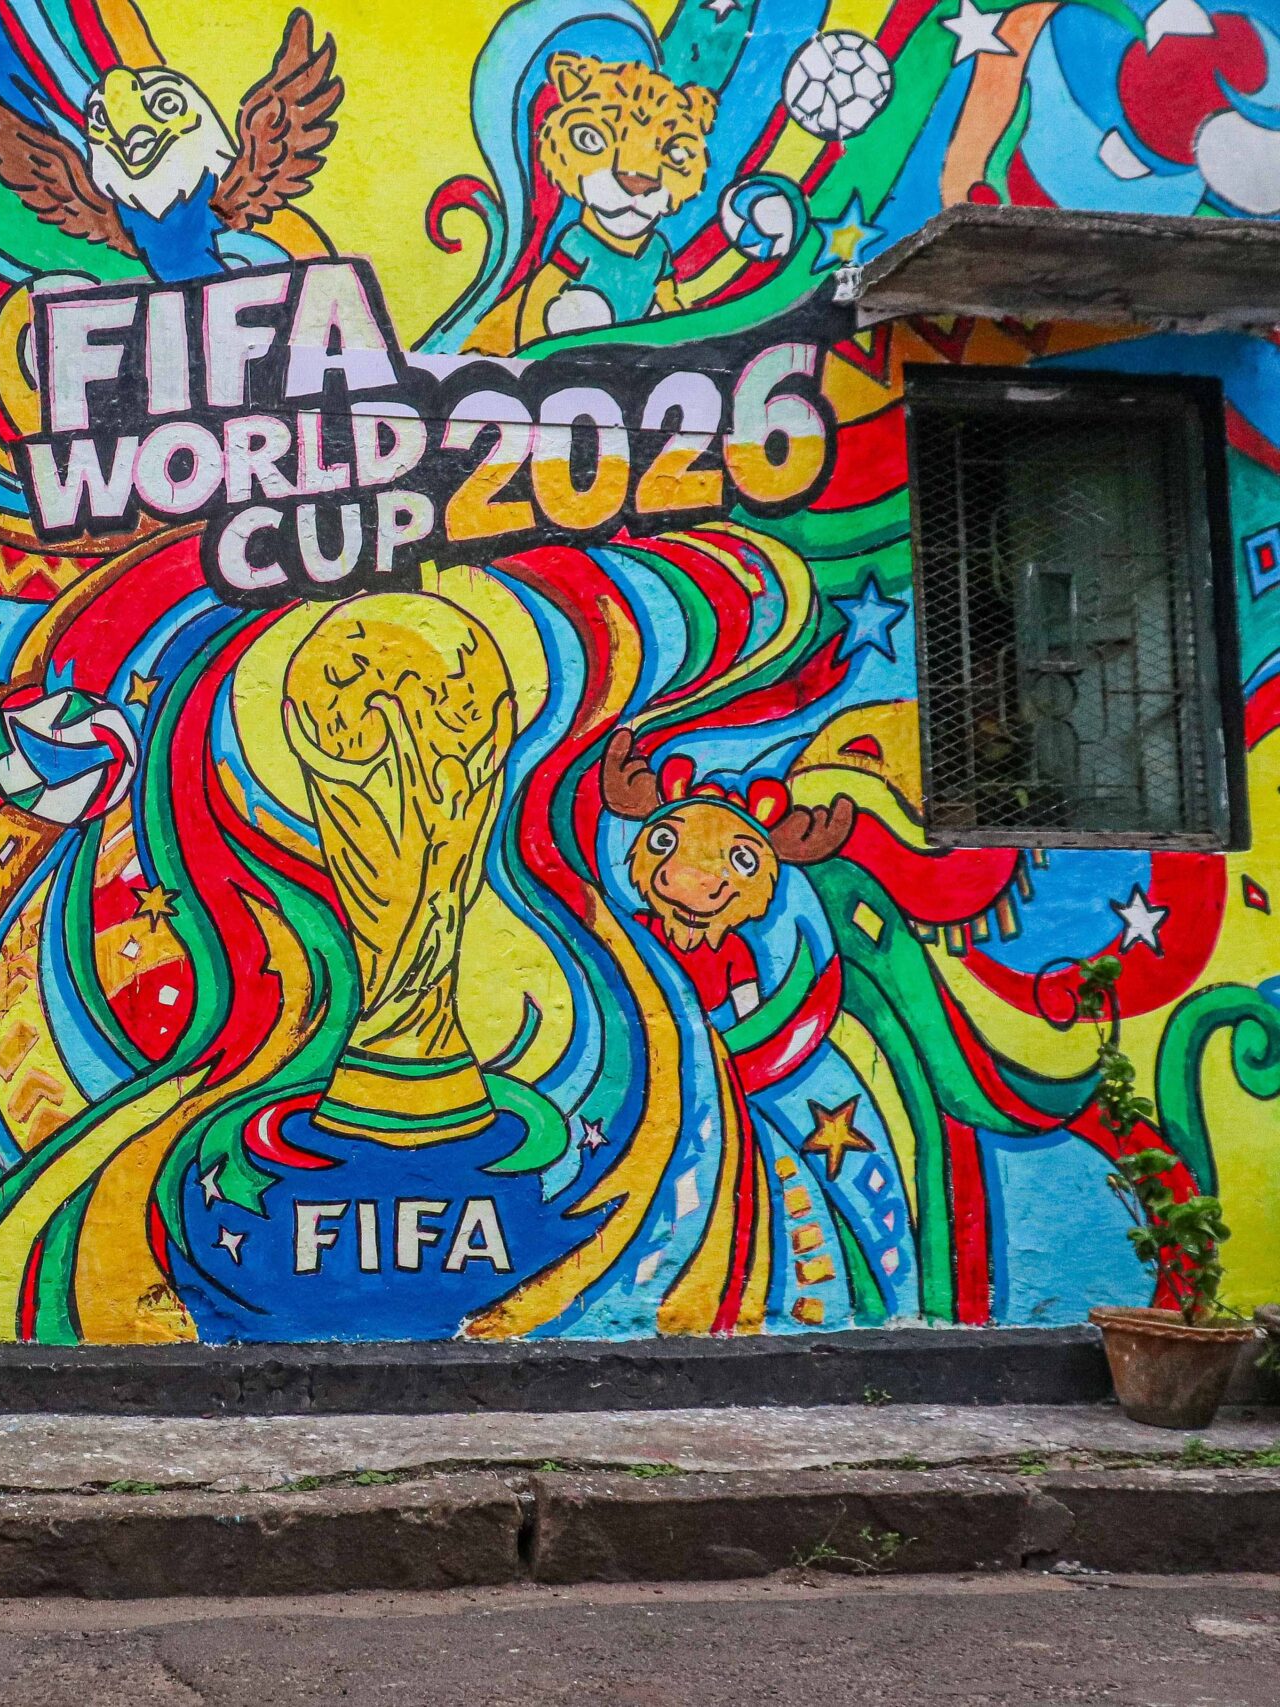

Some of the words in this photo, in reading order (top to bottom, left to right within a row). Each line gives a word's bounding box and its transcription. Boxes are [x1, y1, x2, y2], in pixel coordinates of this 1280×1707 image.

[46, 262, 398, 432] FIFA
[25, 403, 428, 528] WORLD
[444, 343, 826, 542] 2026
[218, 491, 436, 589] CUP
[294, 1197, 514, 1274] FIFA
